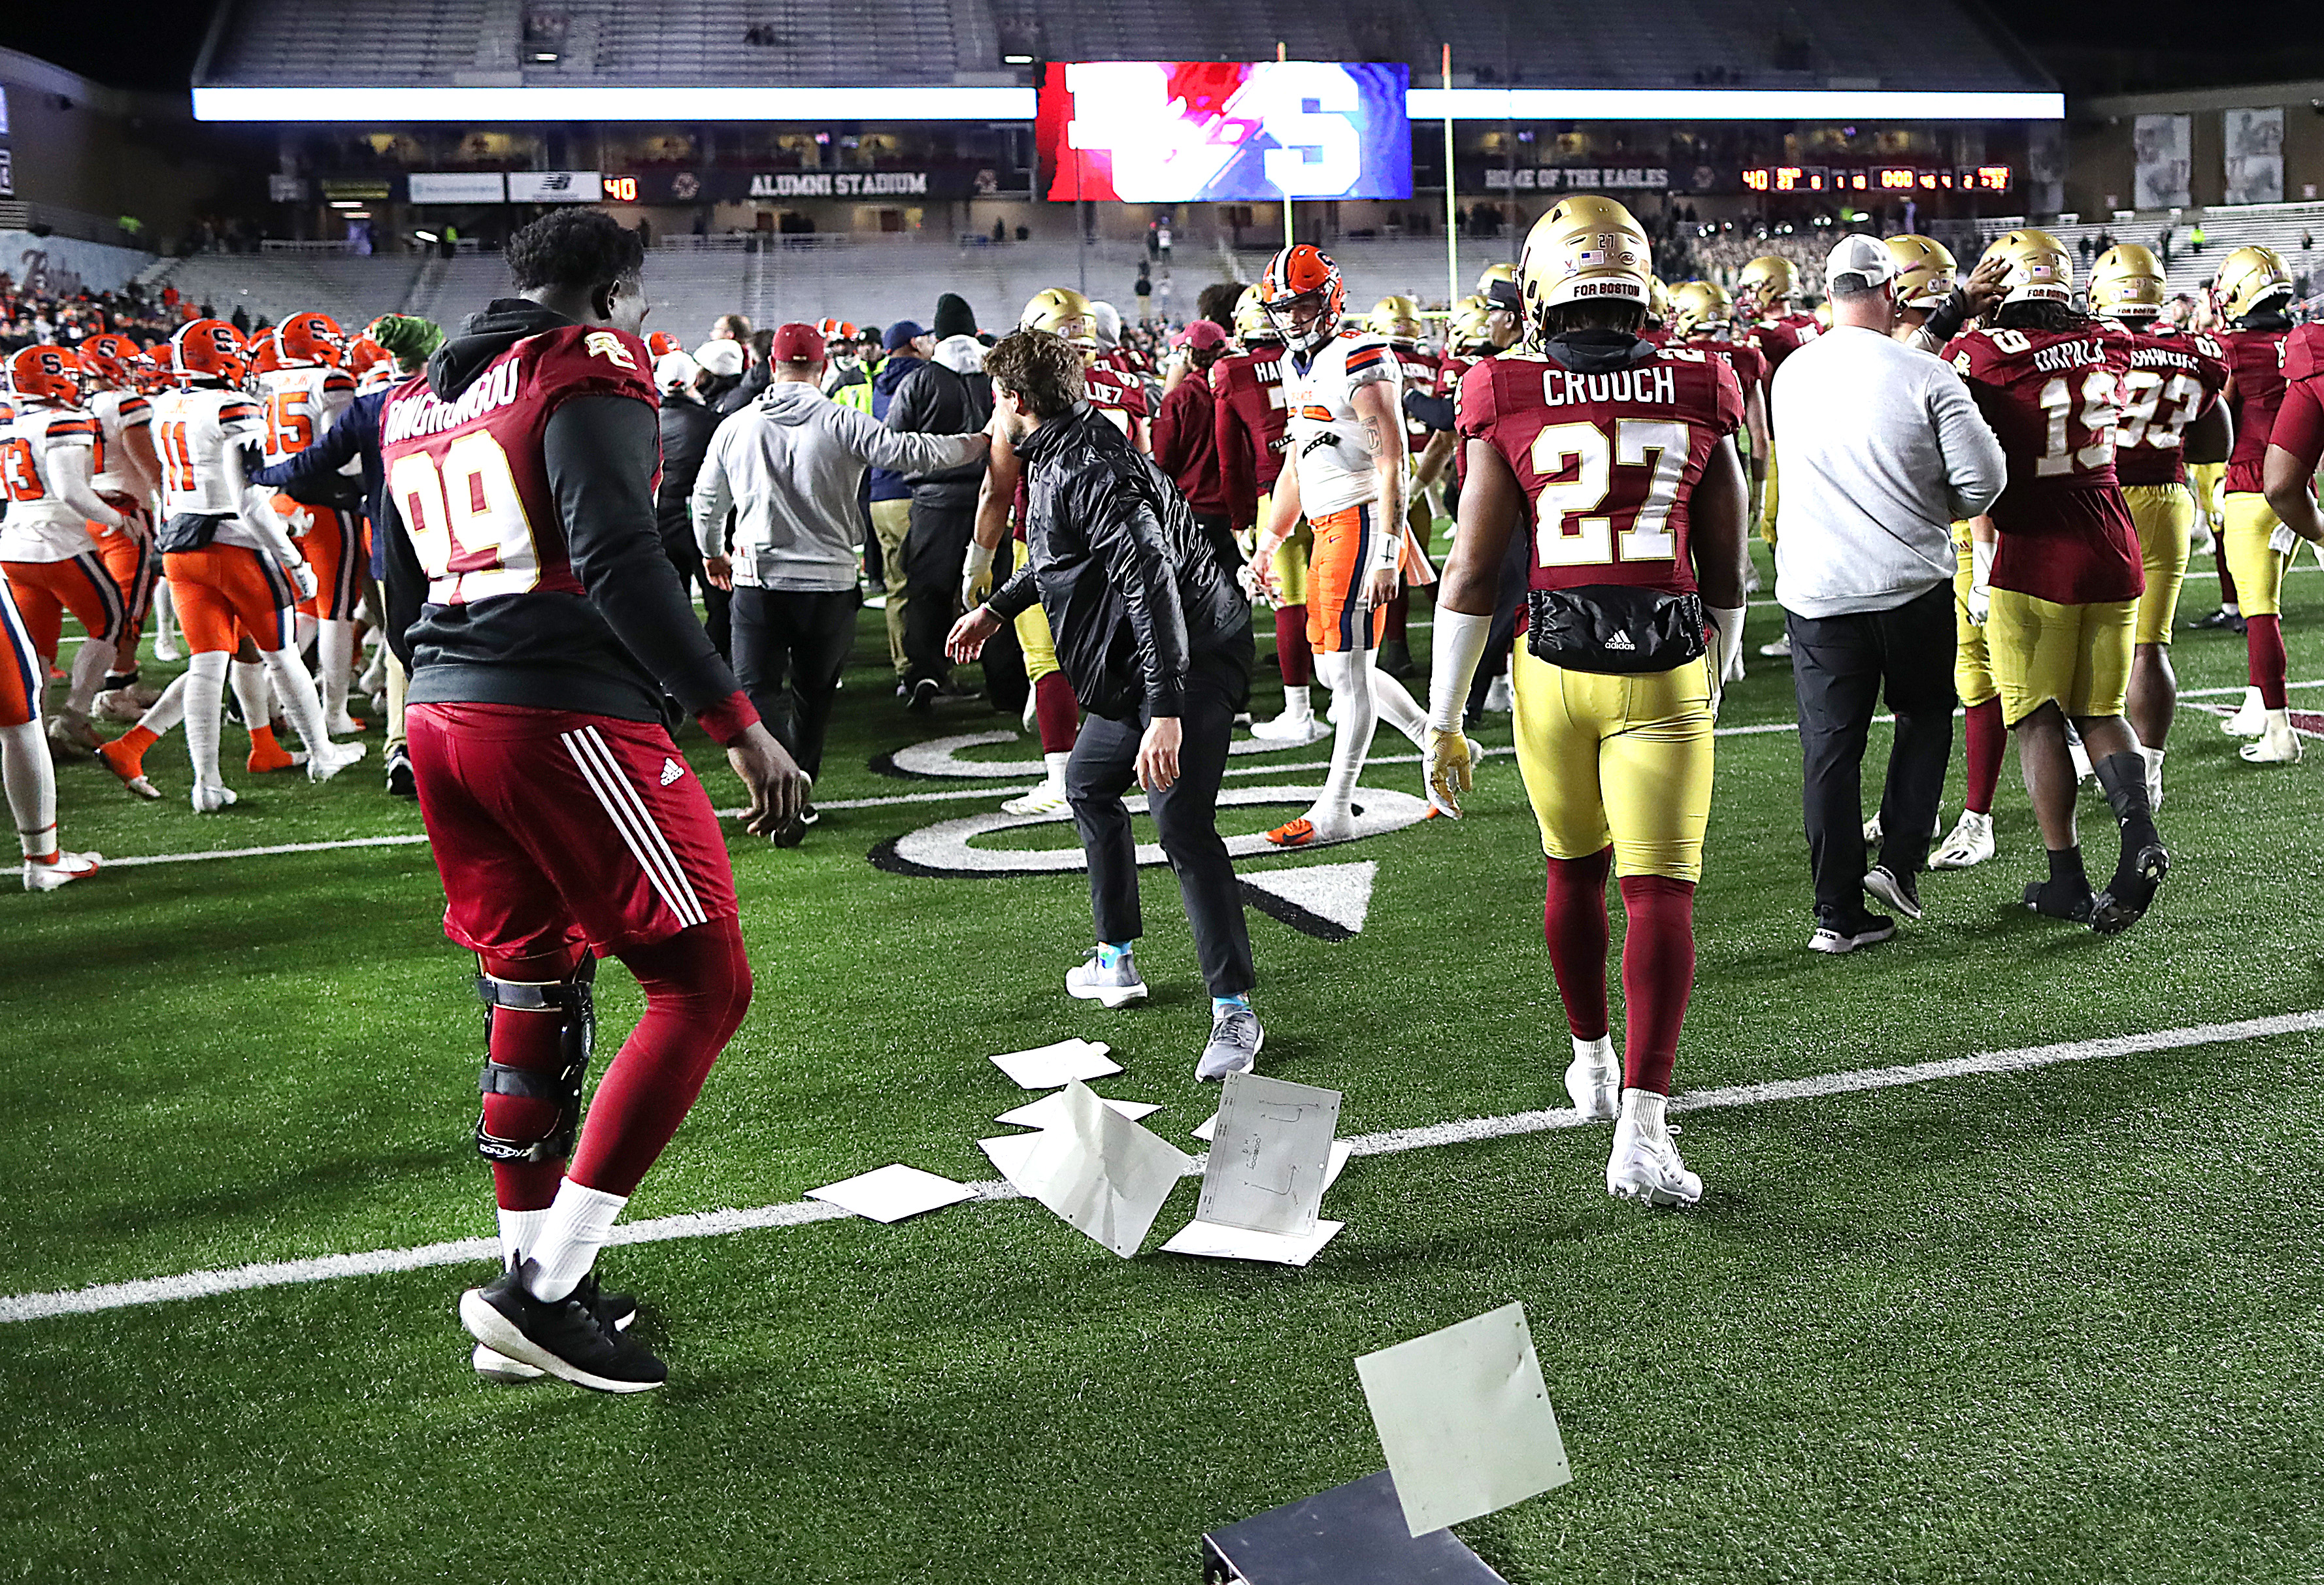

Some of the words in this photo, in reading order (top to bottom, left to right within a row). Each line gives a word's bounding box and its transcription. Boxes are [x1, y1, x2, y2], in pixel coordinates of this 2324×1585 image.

[603, 177, 638, 201] 40
[750, 173, 832, 195] ALUMNI
[835, 172, 927, 195] STADIUM
[1564, 169, 1601, 188] THE
[1603, 169, 1668, 188] EAGLES
[1743, 171, 1768, 189] 40
[1597, 233, 1615, 248] 27
[1574, 284, 1597, 297] FOR
[1599, 282, 1640, 297] BOSTON
[98, 338, 117, 358] S
[41, 353, 63, 375] S
[1543, 367, 1676, 407] CROUCH
[161, 421, 196, 491] 11
[1530, 417, 1690, 568] 27
[391, 429, 540, 606] 99
[1604, 642, 1636, 651] adidas
[480, 1143, 524, 1157] DONJOY
